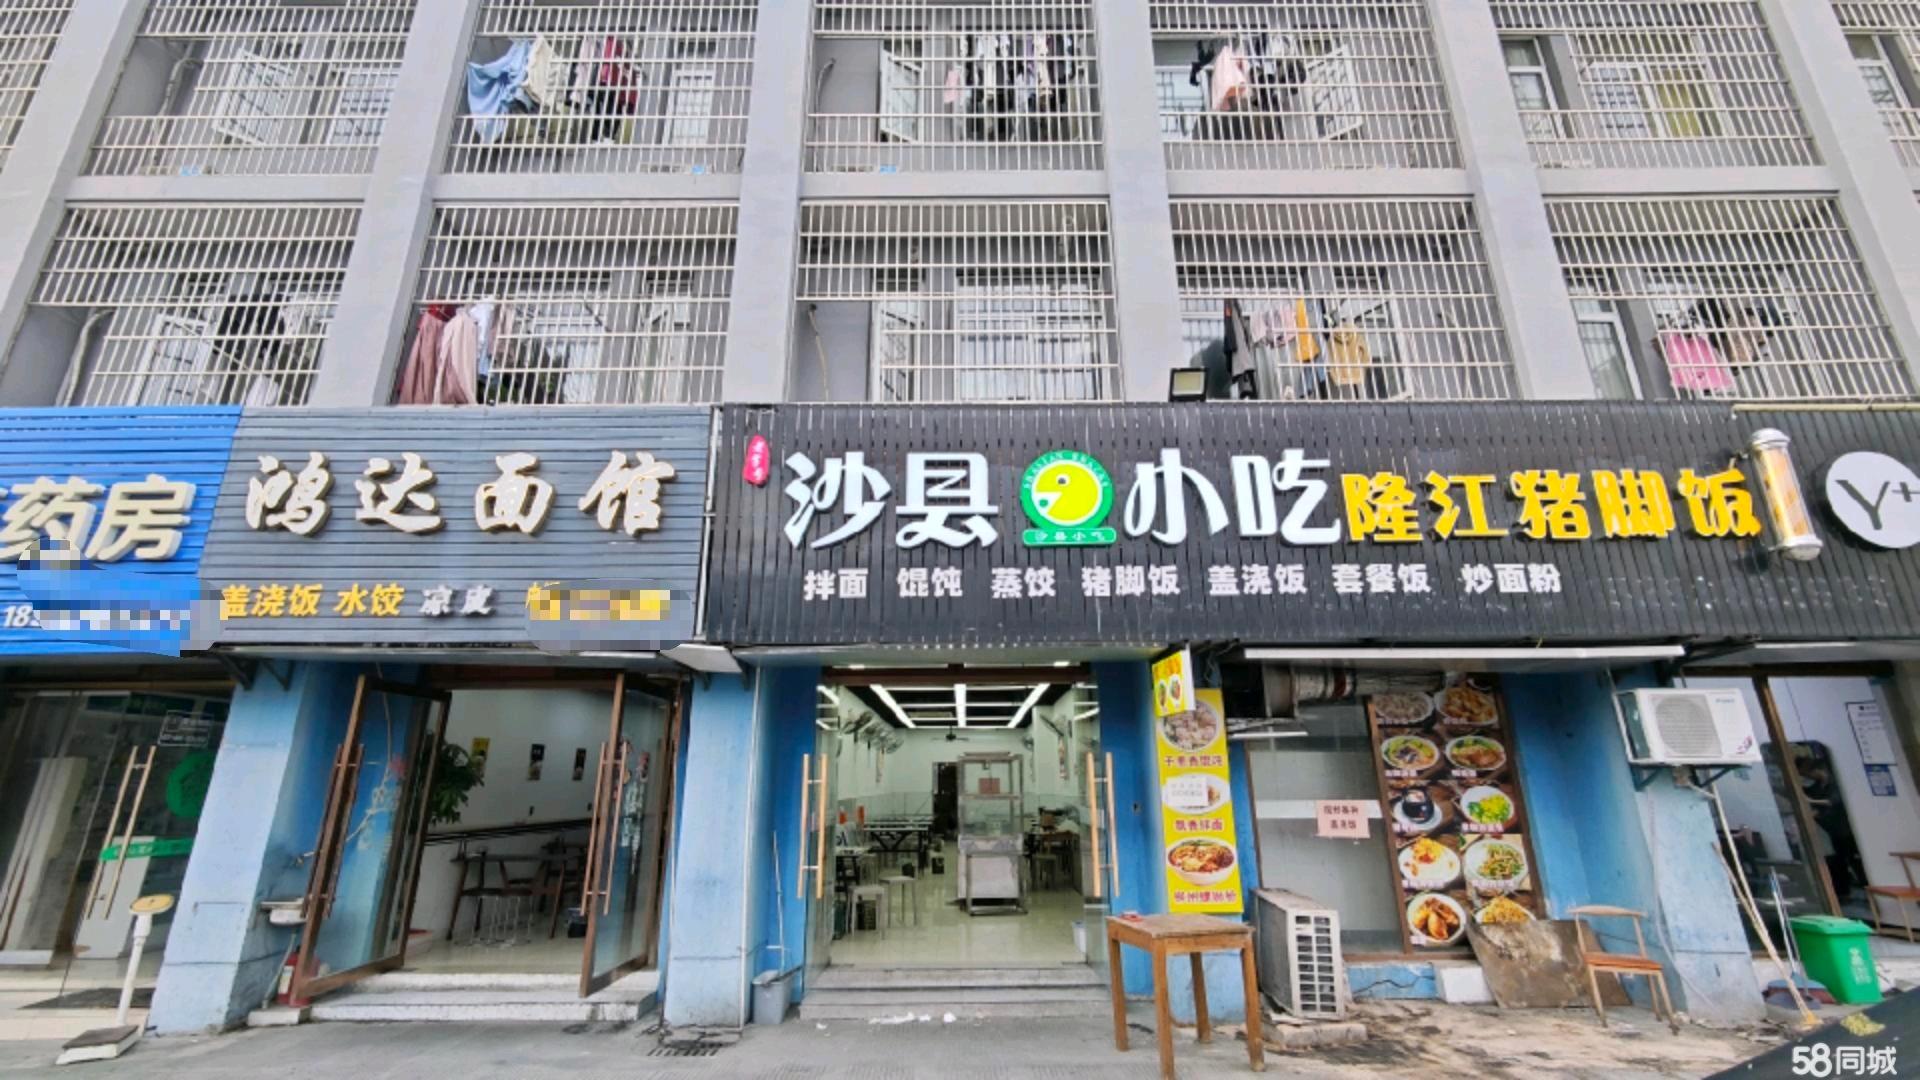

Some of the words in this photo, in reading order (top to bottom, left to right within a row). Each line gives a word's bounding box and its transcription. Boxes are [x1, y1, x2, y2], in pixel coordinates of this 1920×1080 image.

[0, 473, 196, 561] 药房
[246, 451, 675, 534] 鸿达面馆
[784, 450, 999, 549] 沙县
[1123, 447, 1342, 545] 小吃
[1341, 469, 1762, 543] 隆江猪脚饭
[220, 583, 323, 617] 盖浇饭
[333, 583, 405, 617] 水饺
[418, 585, 495, 617] 凉皮
[803, 569, 870, 600] 拌面
[898, 568, 963, 597] 馄饨
[991, 568, 1056, 597] 蒸饺
[1082, 565, 1181, 597] 猪脚饭
[1209, 564, 1308, 596] 盖浇饭
[1332, 564, 1431, 594] 套餐饭
[1461, 564, 1562, 594] 炒面粉
